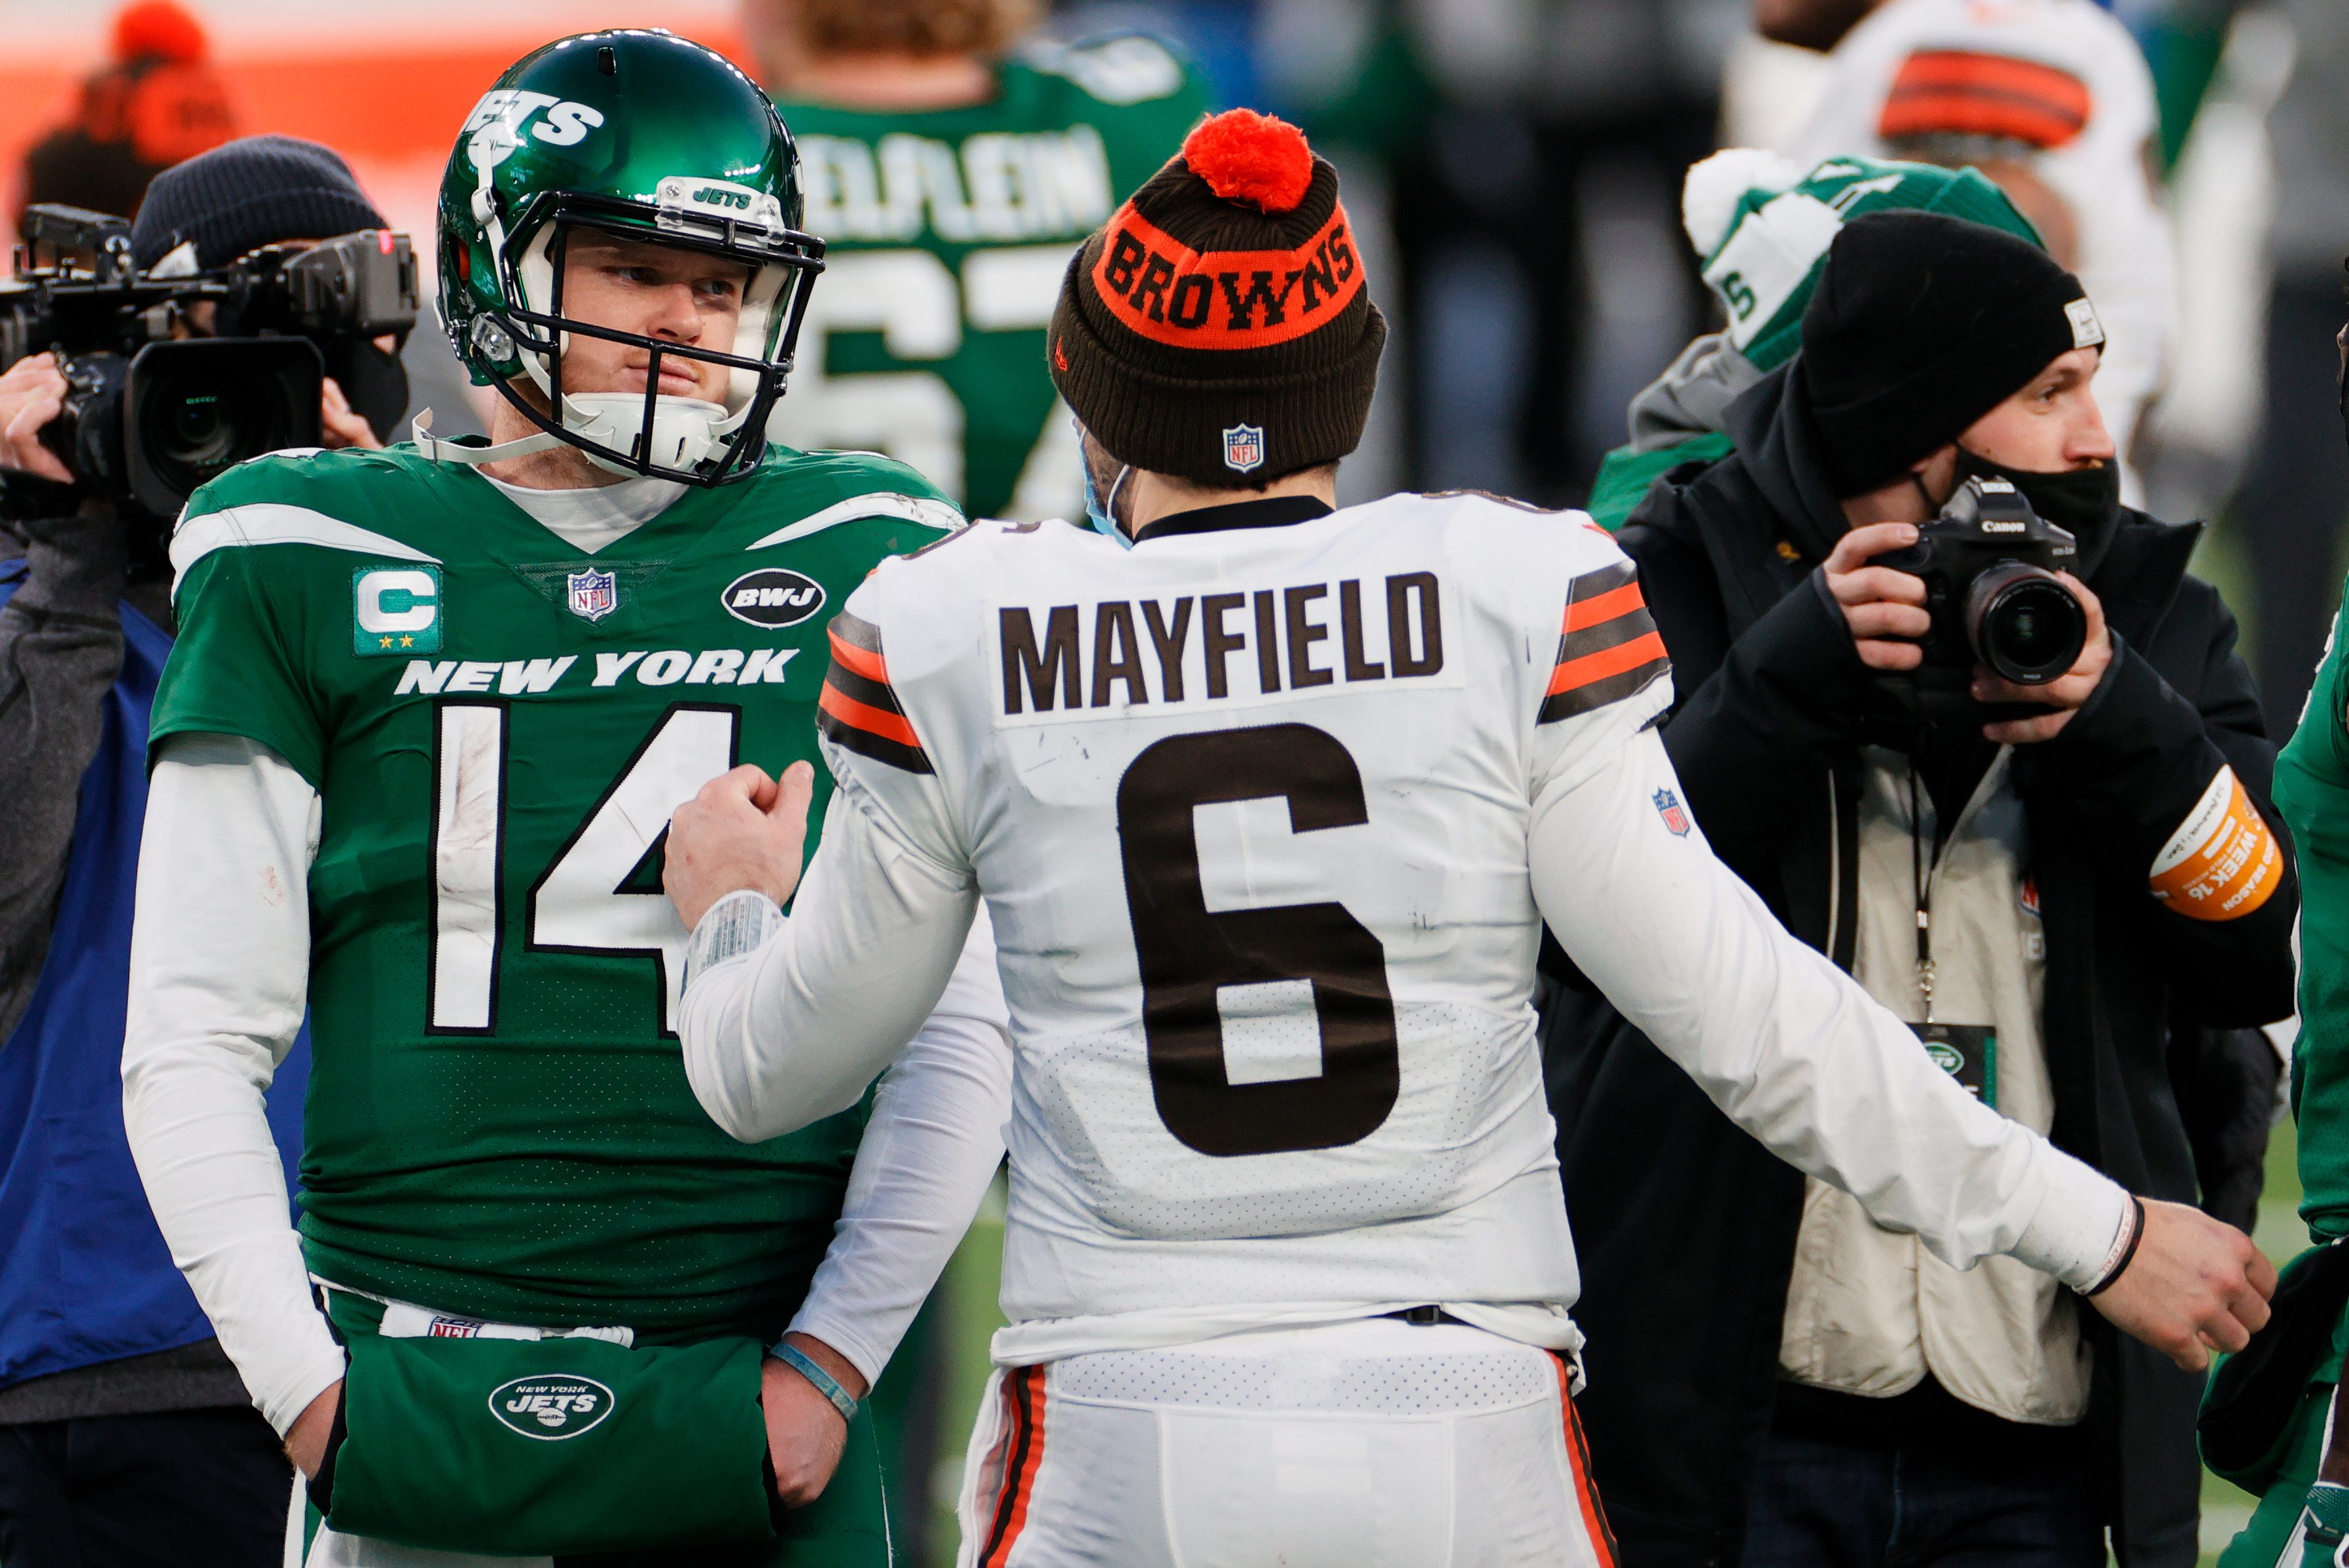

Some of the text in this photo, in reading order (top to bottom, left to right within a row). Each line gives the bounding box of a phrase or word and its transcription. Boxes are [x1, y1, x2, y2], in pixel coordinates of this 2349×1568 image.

[693, 187, 752, 209] JETS
[1103, 223, 1354, 330] BROWNS
[1231, 445, 1257, 463] NFL
[1981, 520, 2026, 533] Canon
[357, 570, 436, 633] C
[577, 590, 608, 611] NFL
[731, 587, 817, 607] BWJ
[999, 571, 1444, 716] MAYFIELD
[393, 648, 801, 696] NEW YORK
[425, 698, 742, 1041] 14
[2210, 830, 2257, 888] WEEK
[2188, 883, 2215, 900] 16
[2221, 863, 2268, 912] SEASON
[1115, 721, 1401, 1158] 6
[506, 1395, 597, 1413] JETS
[550, 1384, 590, 1393] YORK
